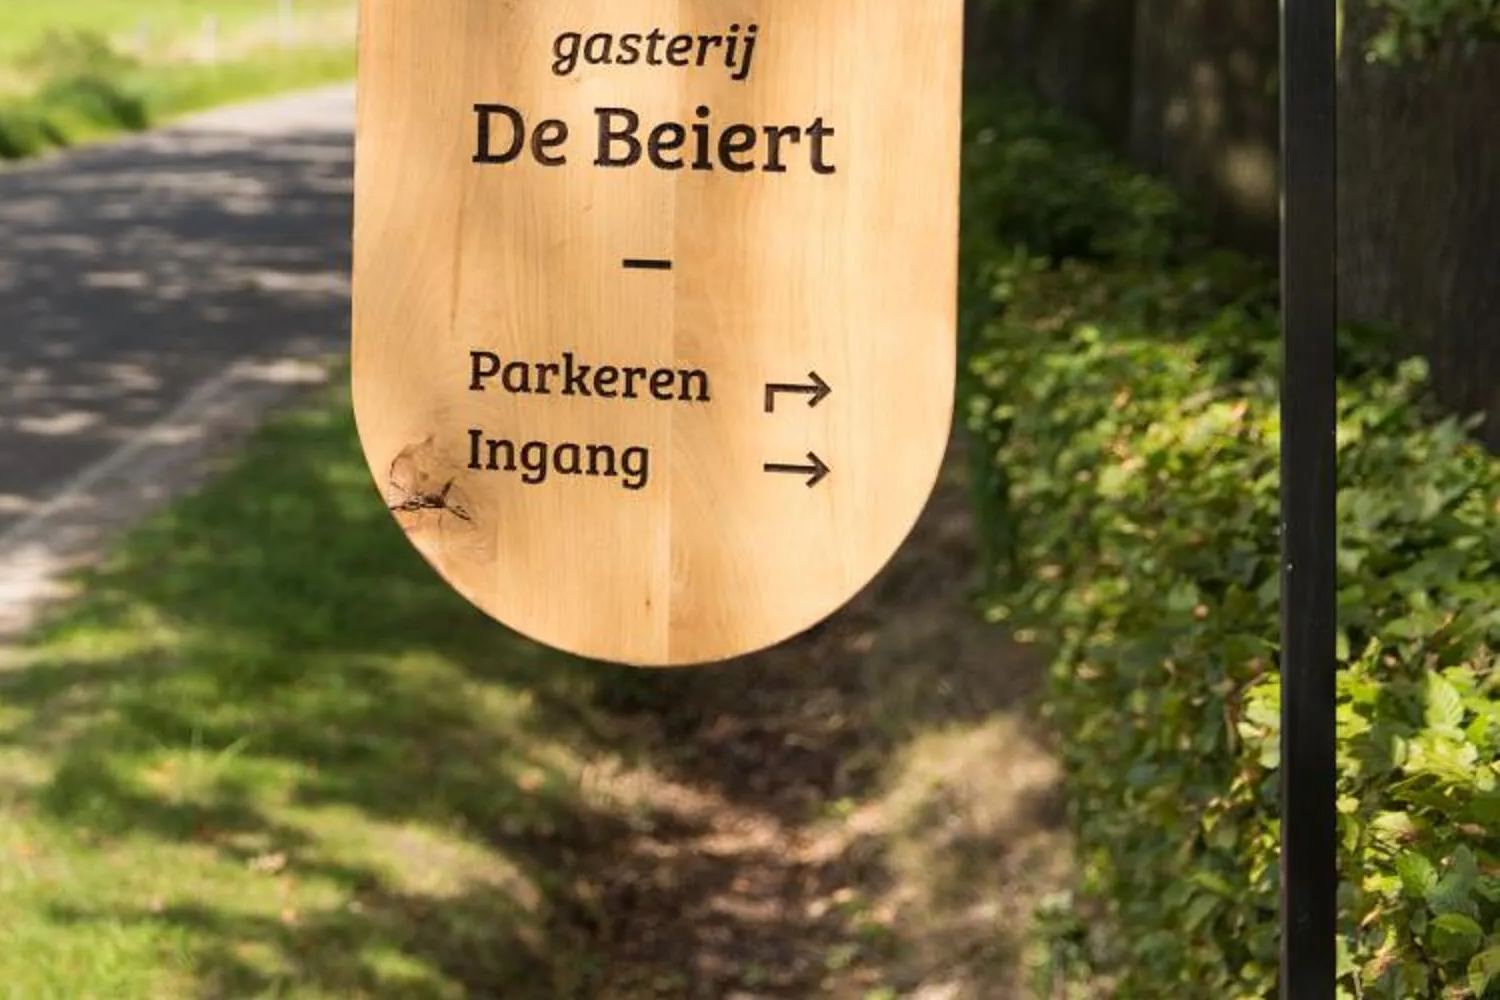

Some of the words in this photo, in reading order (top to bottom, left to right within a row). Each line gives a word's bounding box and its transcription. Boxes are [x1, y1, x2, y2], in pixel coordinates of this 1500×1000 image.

[551, 23, 759, 80] gasterij
[471, 103, 569, 167] De
[593, 105, 836, 175] Beiert
[468, 350, 711, 403] Parkeren
[467, 428, 650, 491] Ingang
